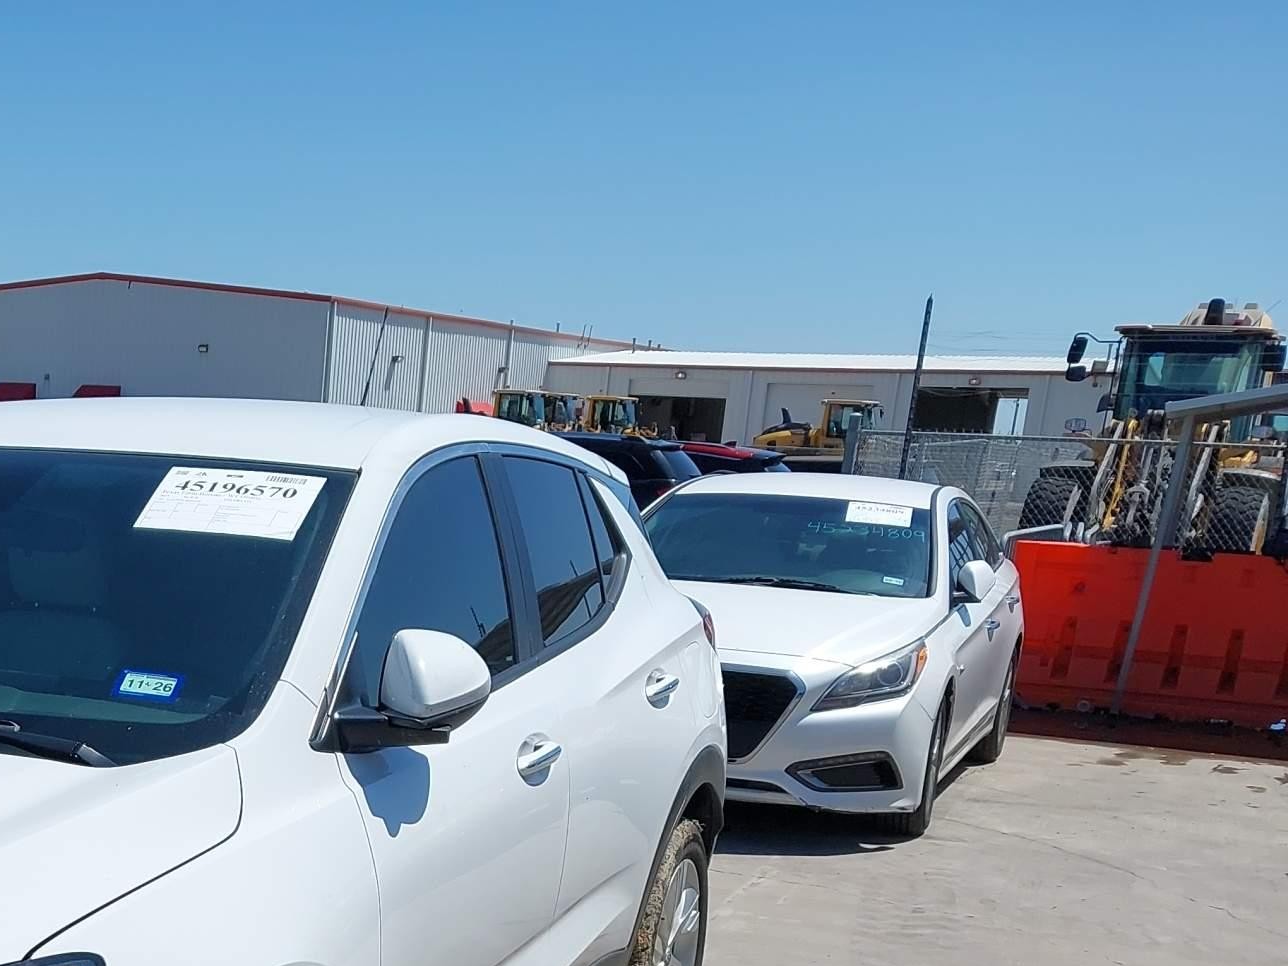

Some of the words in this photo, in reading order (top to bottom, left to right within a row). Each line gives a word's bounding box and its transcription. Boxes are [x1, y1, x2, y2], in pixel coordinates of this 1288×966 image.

[175, 479, 298, 499] 45196570
[128, 679, 145, 689] 11
[152, 681, 173, 692] 26
